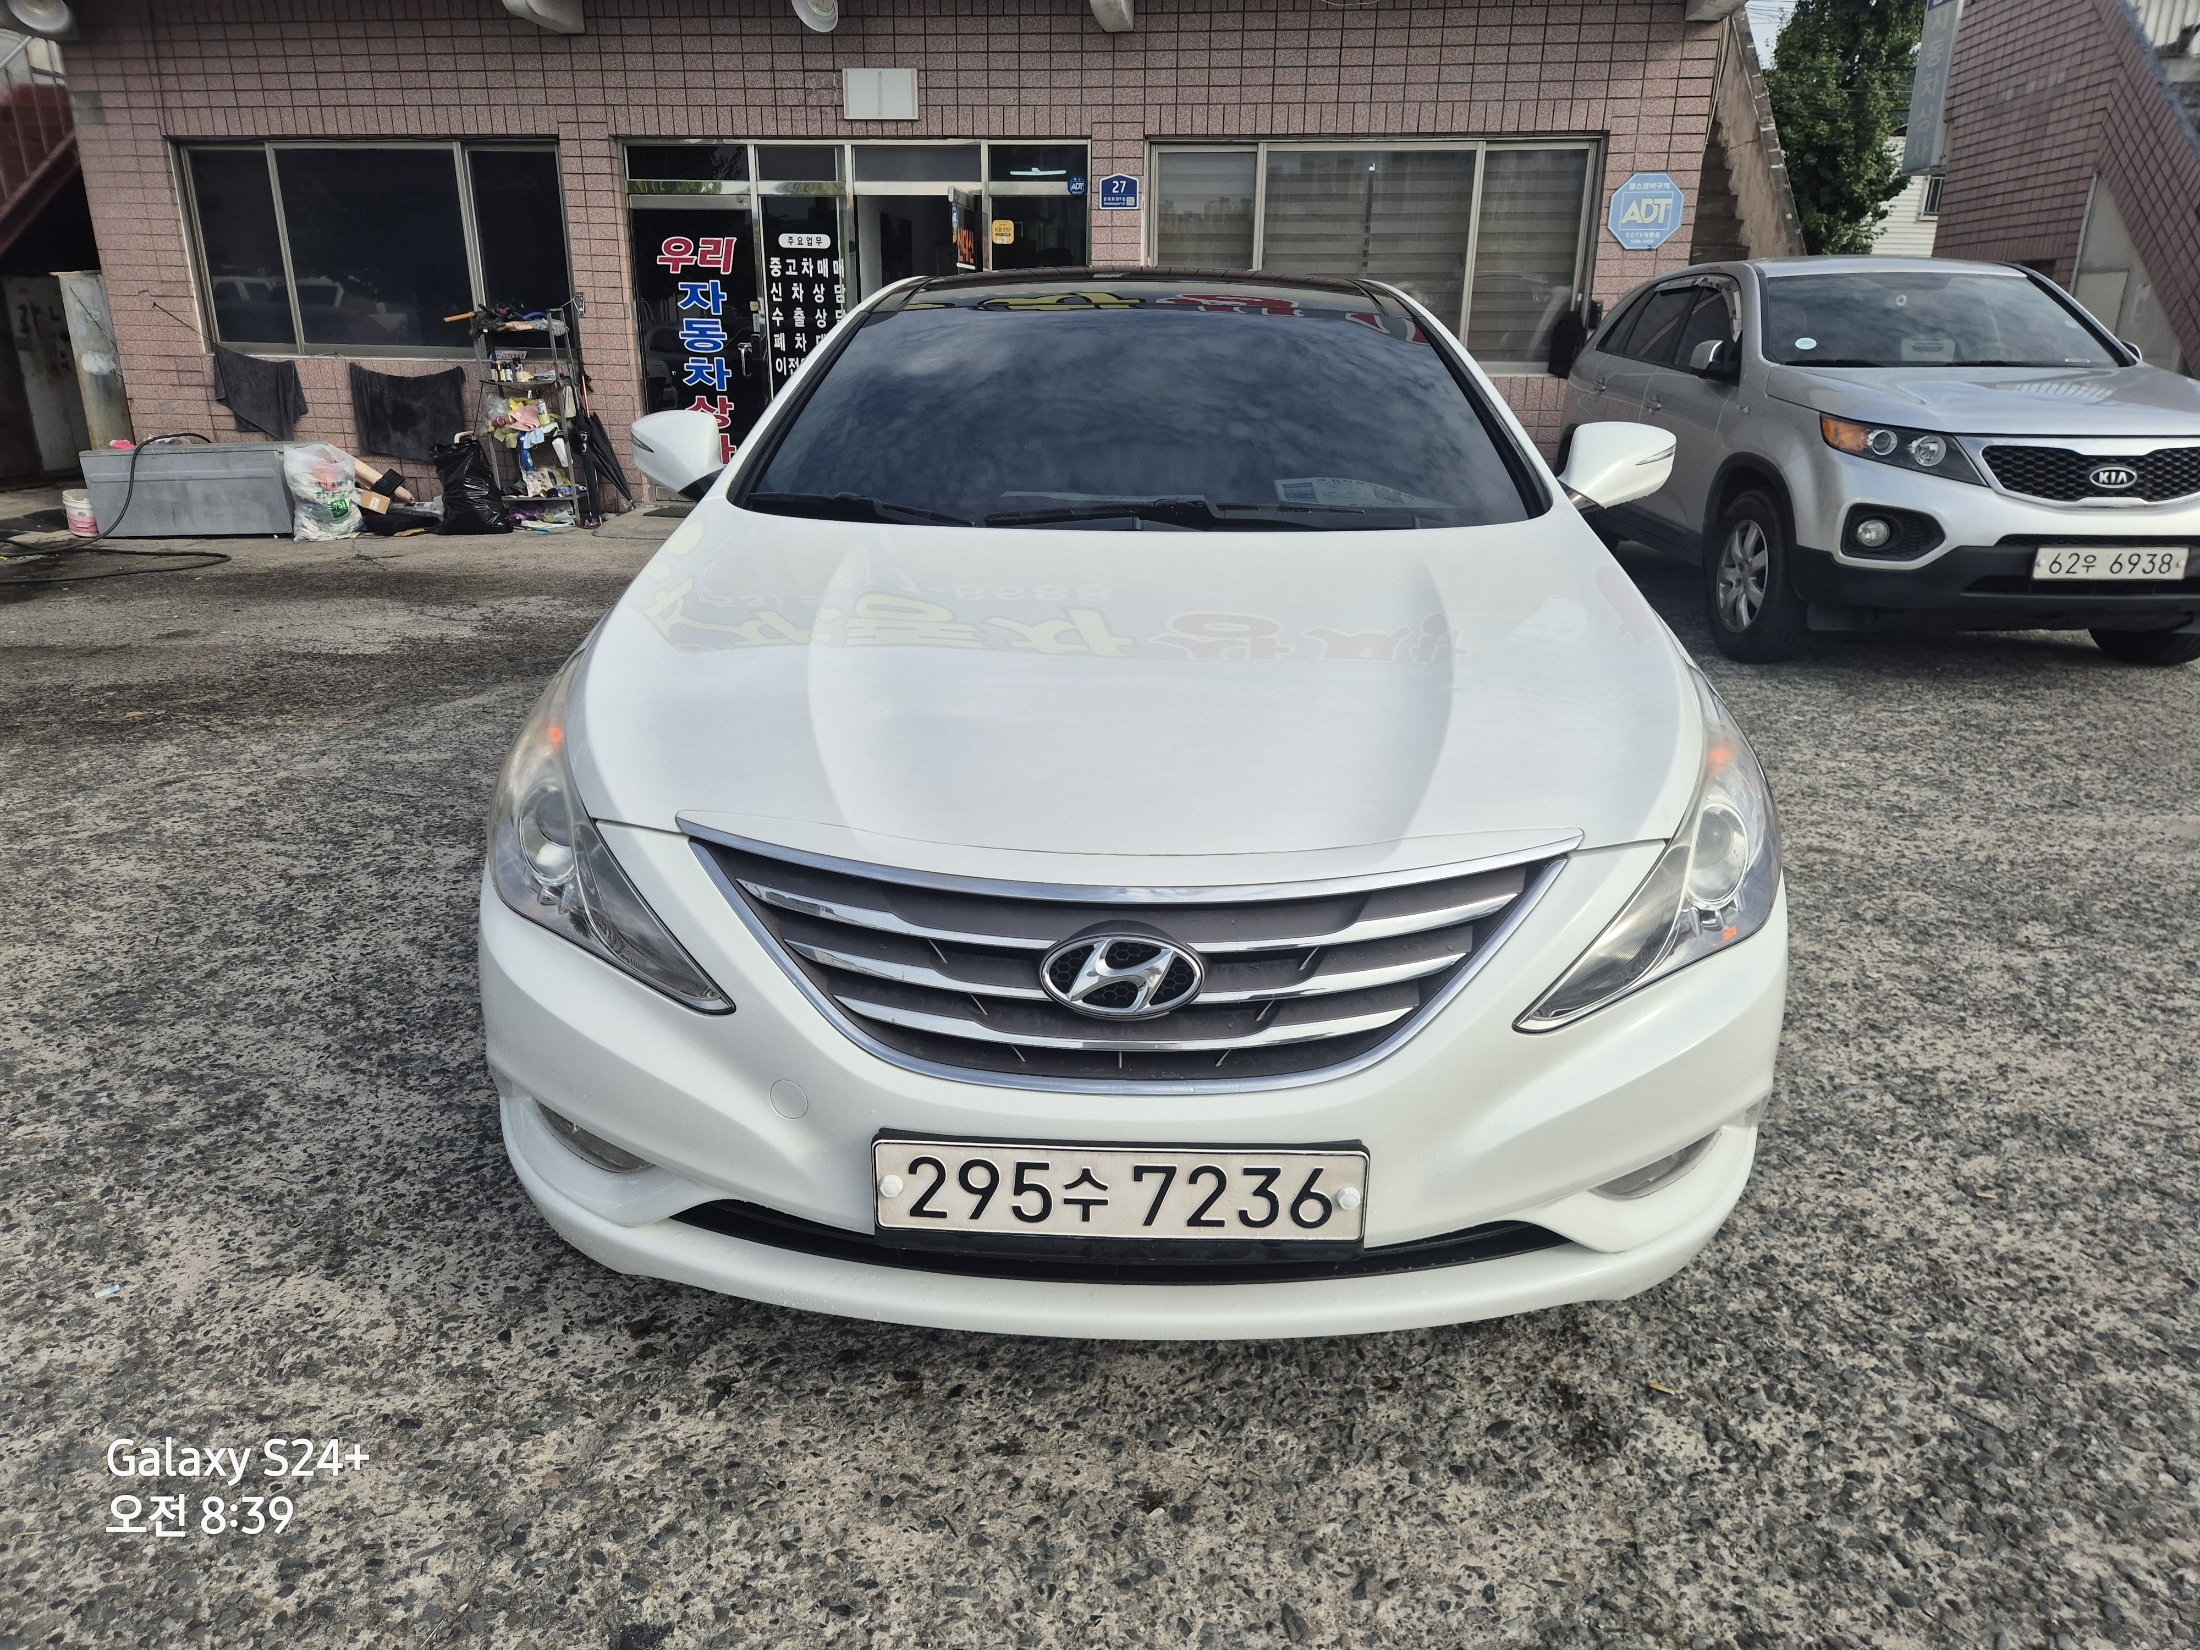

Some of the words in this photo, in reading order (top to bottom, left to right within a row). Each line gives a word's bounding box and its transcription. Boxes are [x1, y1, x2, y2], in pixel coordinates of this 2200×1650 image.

[1070, 182, 1085, 191] ADT
[1112, 180, 1127, 194] 27
[1621, 198, 1672, 223] ADT
[787, 235, 823, 247] 주요업무
[656, 236, 737, 275] 우리
[2098, 471, 2128, 484] KIA
[2048, 552, 2097, 575] 62우
[2109, 552, 2174, 575] 6938
[907, 1155, 1110, 1224] 295수
[1132, 1164, 1334, 1230] 7236
